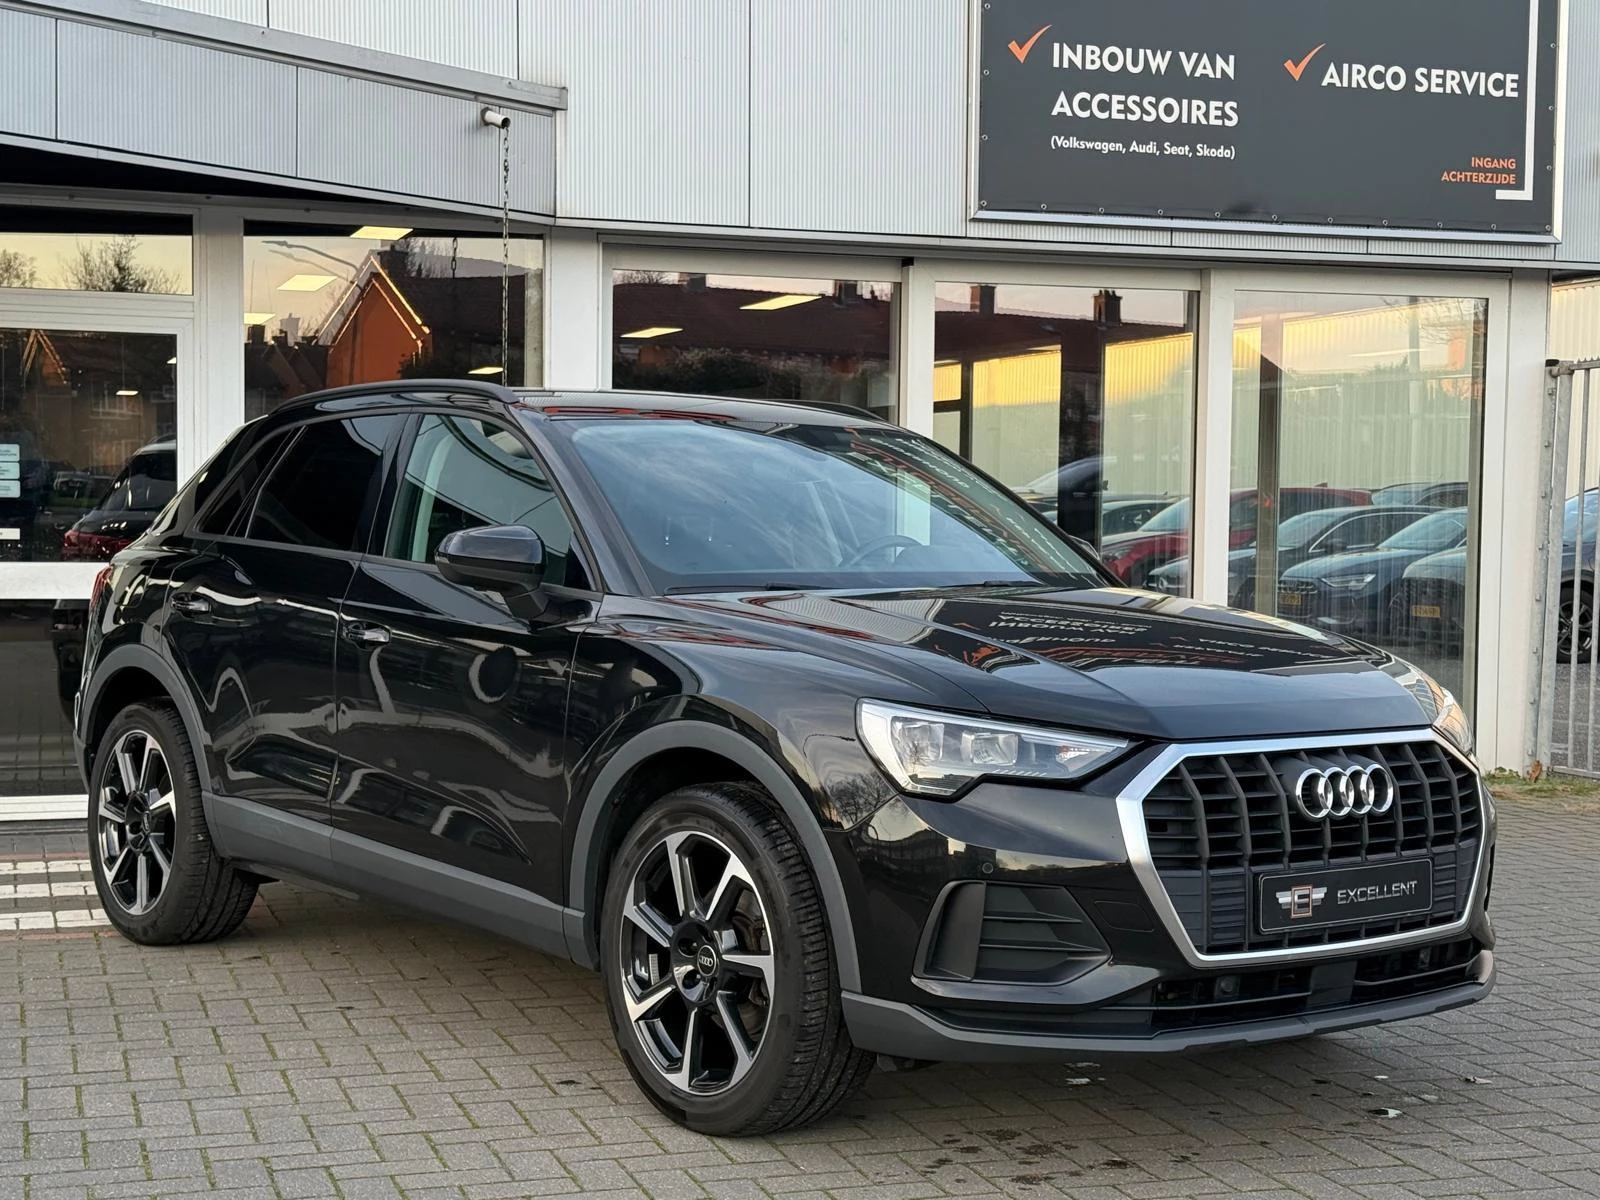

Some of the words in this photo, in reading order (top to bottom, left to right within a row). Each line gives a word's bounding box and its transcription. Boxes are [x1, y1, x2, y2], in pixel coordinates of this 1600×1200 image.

[1052, 42, 1173, 76] INBOUW
[1178, 50, 1236, 80] VAN
[1320, 61, 1407, 92] AIRCO
[1414, 67, 1520, 98] SERVICE
[1050, 90, 1239, 127] ACCESSOIRES
[1050, 135, 1127, 154] (Volkswagen,
[1128, 140, 1161, 156] Audi,
[1163, 141, 1194, 158] Seat,
[1196, 143, 1237, 160] Skoda)
[1471, 156, 1516, 170] INGANG
[1440, 170, 1516, 185] ACHTERZIJDE
[1336, 880, 1418, 905] EXCELLENT
